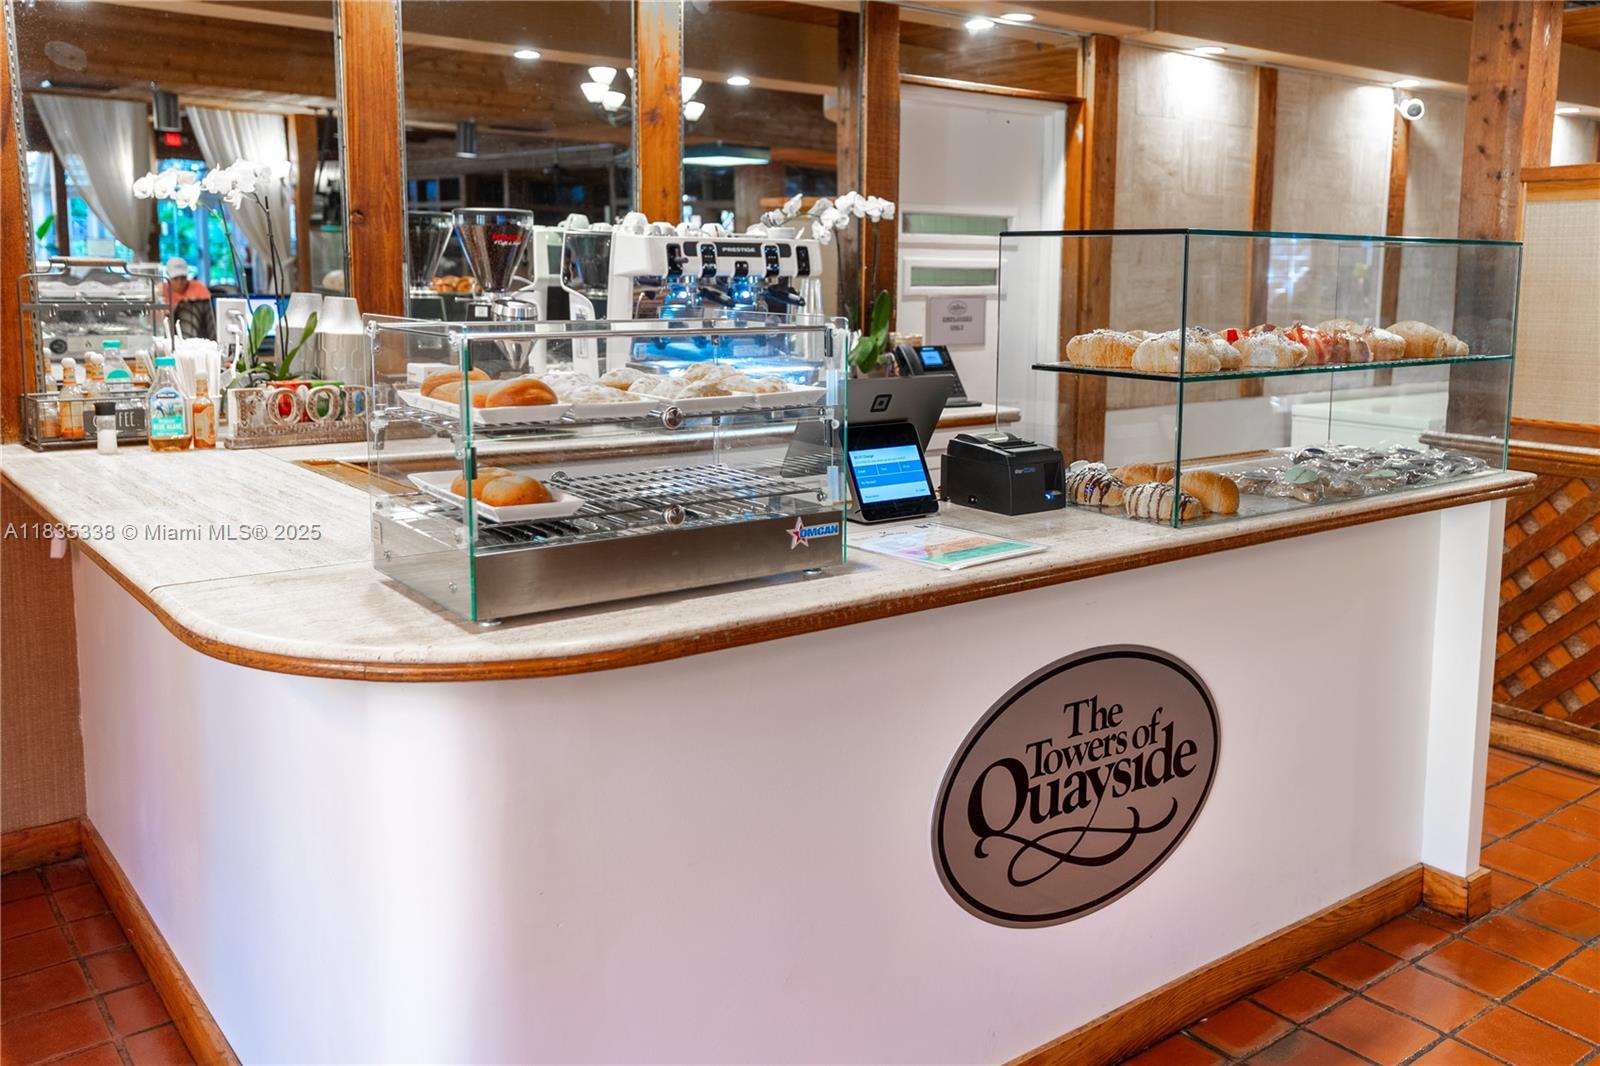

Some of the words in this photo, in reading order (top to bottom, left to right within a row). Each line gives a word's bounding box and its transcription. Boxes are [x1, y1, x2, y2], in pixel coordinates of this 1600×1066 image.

[799, 523, 840, 538] OMCAN
[1026, 730, 1128, 780] Towers
[1132, 706, 1164, 750] of
[1063, 694, 1124, 739] The
[967, 720, 1198, 862] Quayside
